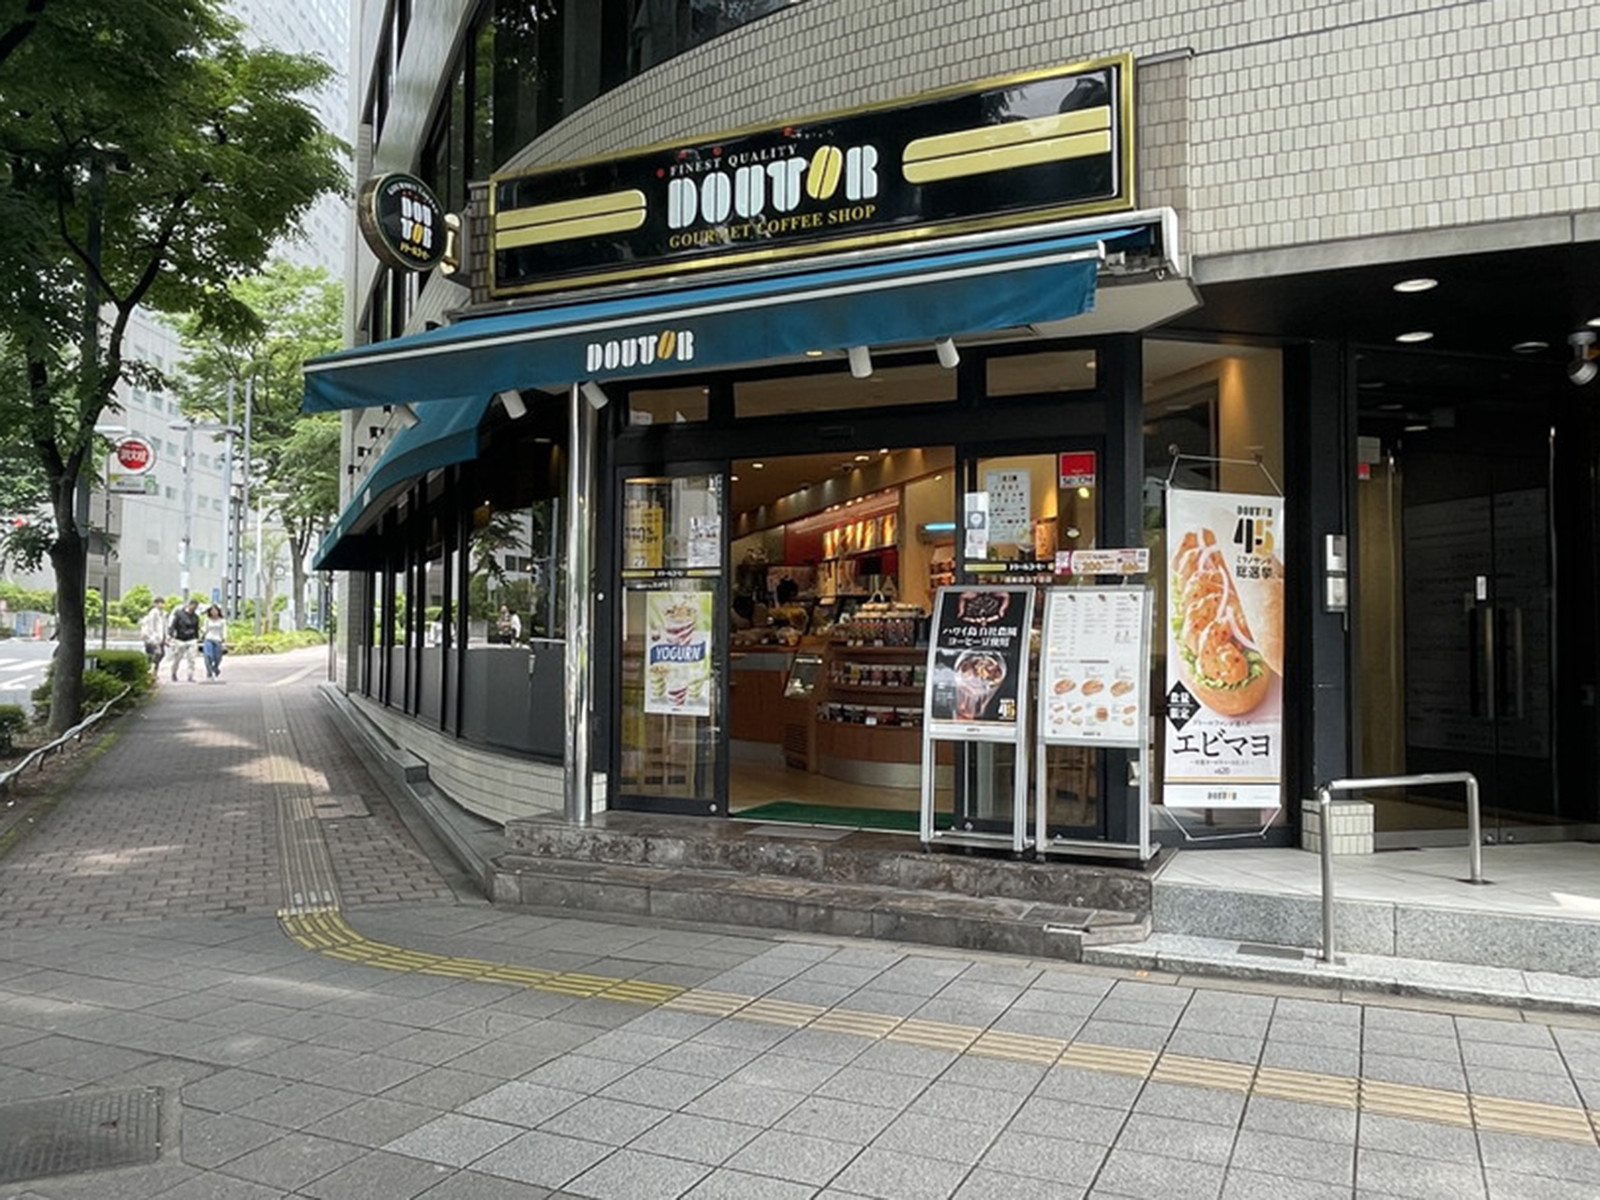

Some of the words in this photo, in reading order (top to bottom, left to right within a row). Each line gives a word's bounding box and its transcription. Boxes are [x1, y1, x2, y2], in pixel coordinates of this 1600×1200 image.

[669, 157, 722, 177] FINEST
[728, 143, 798, 168] QUALITY
[667, 144, 879, 230] DOUTOR
[669, 224, 750, 249] GOURMET
[755, 212, 823, 235] COFFEE
[827, 204, 876, 225] SHOP
[586, 329, 694, 373] DOUTOR
[1233, 517, 1275, 556] 45
[1172, 727, 1271, 758] エビマヨ
